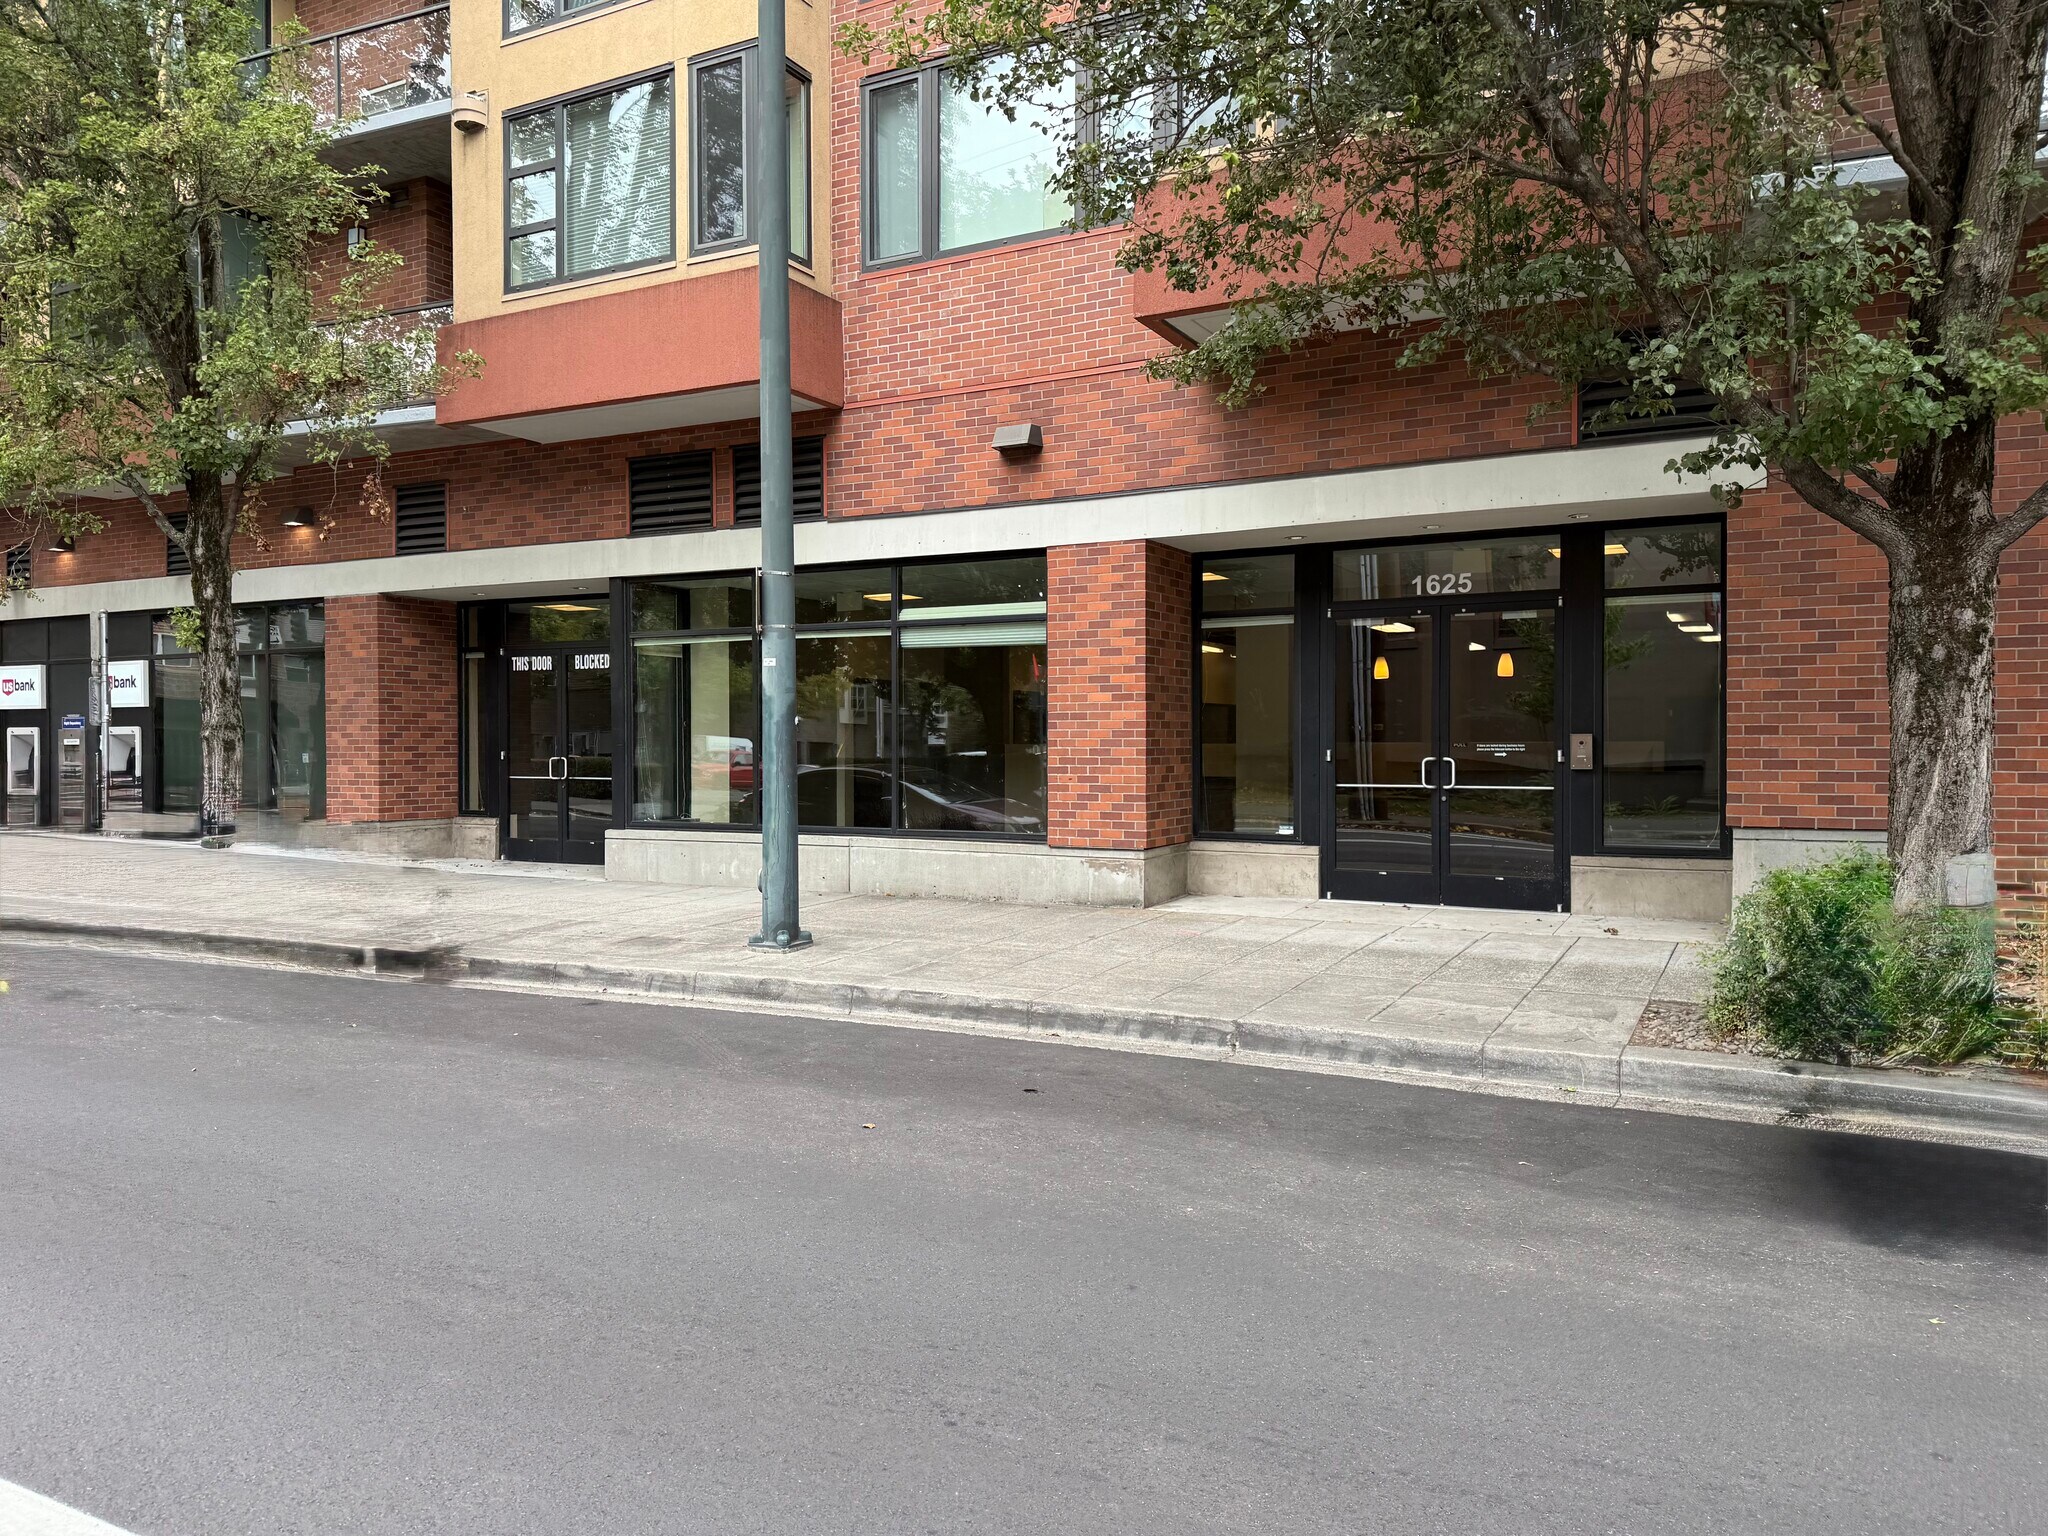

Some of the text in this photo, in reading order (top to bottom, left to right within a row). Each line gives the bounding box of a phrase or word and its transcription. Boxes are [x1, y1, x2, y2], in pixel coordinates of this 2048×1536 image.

[1411, 572, 1472, 596] 1625
[511, 653, 610, 671] THIS DOOR BLOCKED
